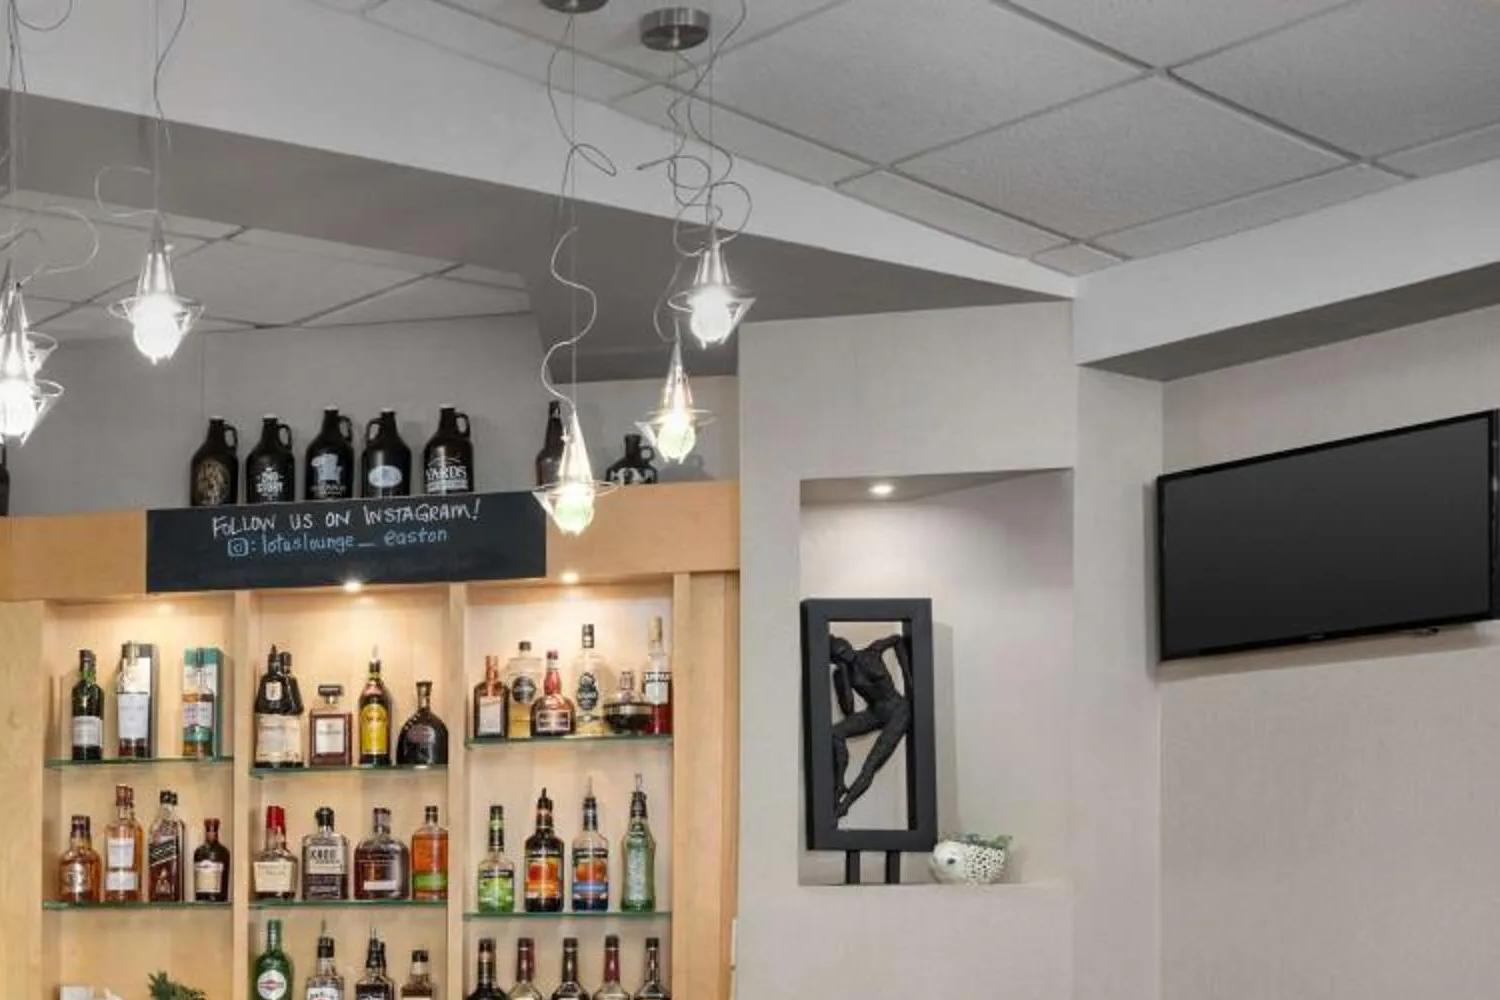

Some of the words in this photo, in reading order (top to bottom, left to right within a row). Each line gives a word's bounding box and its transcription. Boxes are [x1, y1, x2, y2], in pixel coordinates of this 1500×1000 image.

[212, 513, 277, 538] FOLLOW
[289, 512, 313, 531] US
[325, 510, 351, 528] ON
[363, 498, 480, 525] INSTAGRAM!
